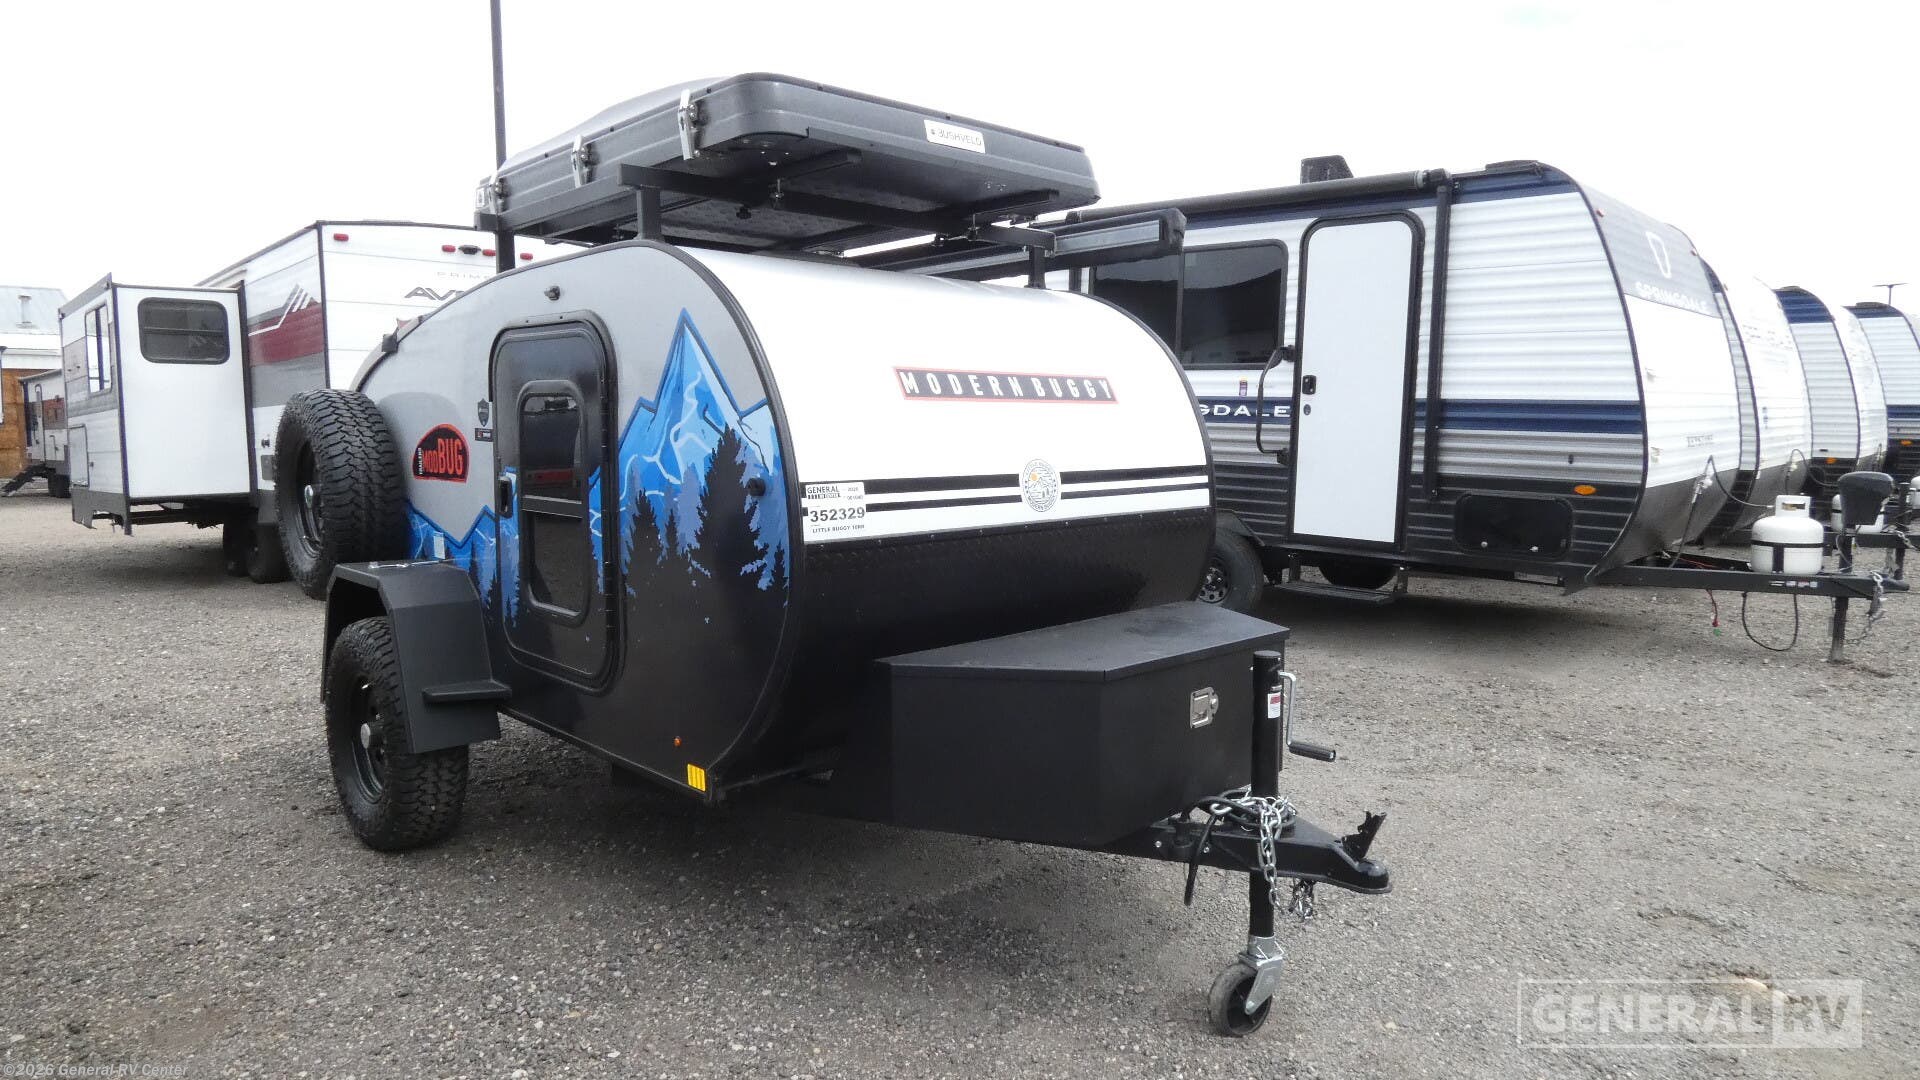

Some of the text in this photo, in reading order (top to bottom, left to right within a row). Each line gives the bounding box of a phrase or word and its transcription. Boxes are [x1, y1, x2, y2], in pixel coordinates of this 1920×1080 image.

[938, 129, 982, 146] BUSHVELD
[899, 371, 1112, 399] MODERN BUGGY
[806, 485, 840, 494] GENERAL
[809, 507, 865, 523] 352329
